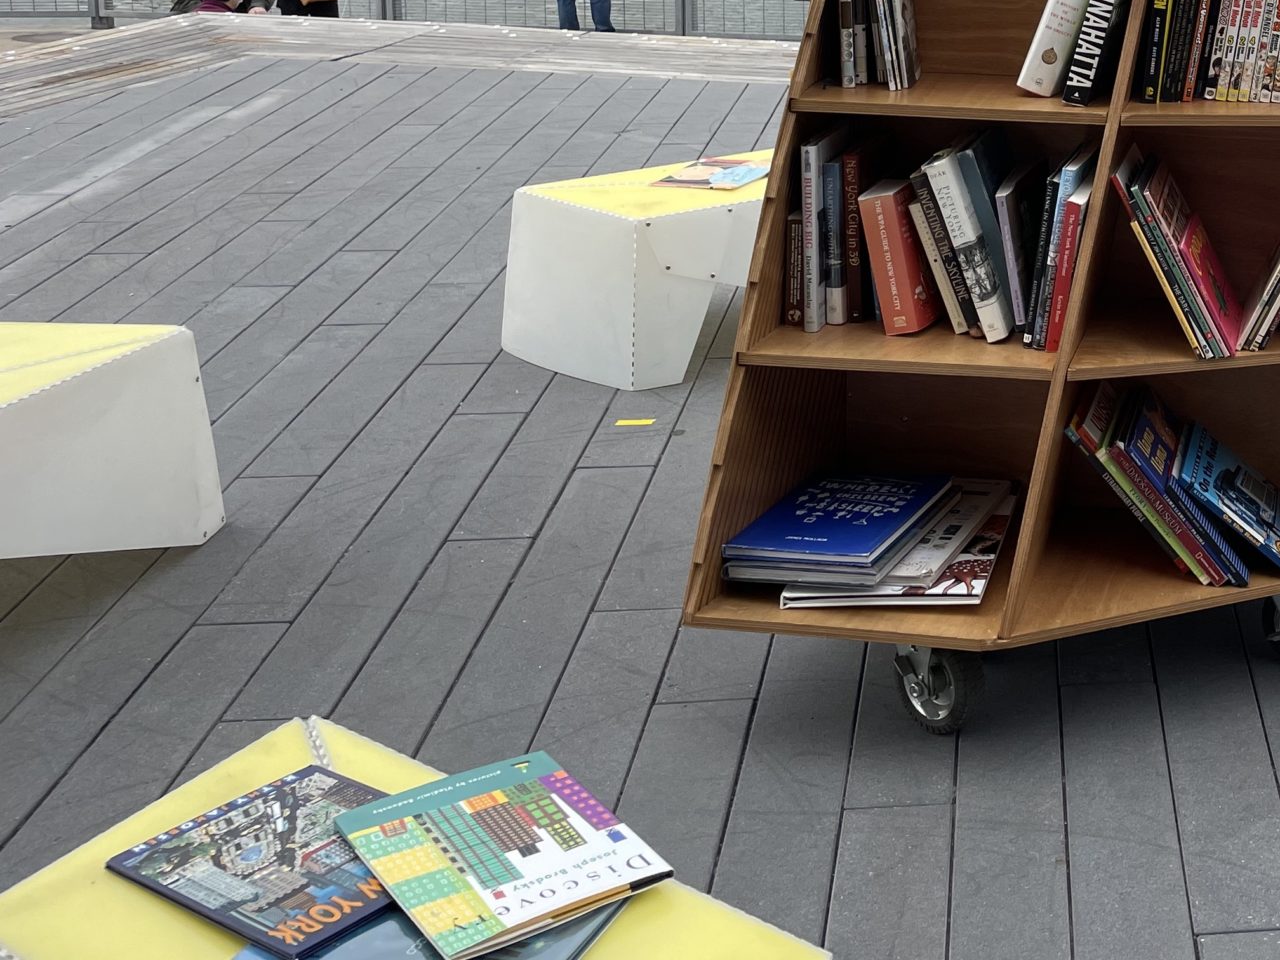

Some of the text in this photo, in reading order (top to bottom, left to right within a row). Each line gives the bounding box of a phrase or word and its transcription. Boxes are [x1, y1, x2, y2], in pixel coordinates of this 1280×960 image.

[1229, 9, 1238, 27] Moon
[1241, 10, 1250, 27] Moon
[1251, 10, 1260, 27] Moon
[1227, 36, 1234, 45] 5
[1239, 36, 1246, 46] 2
[1249, 36, 1256, 45] 4
[873, 200, 882, 214] THE
[1043, 185, 1052, 211] TITANIC
[1052, 170, 1072, 245] BEYOND THE EDGE
[803, 177, 813, 248] BUILDING BIG
[845, 159, 858, 266] New York City in 3D
[935, 186, 959, 239] NEW YORK
[942, 185, 965, 238] PICTURING
[1042, 212, 1048, 220] IN
[878, 228, 889, 251] GUIDE
[917, 186, 968, 302] INVENTING THE SKYLINE
[883, 251, 891, 261] TO
[885, 261, 894, 277] NEW
[1060, 249, 1071, 277] Waterfront
[804, 277, 812, 308] Macaulay
[888, 277, 897, 296] YORK
[1171, 284, 1189, 313] THE DARK
[891, 295, 901, 311] CITY
[1055, 294, 1064, 311] Kevin
[1039, 311, 1050, 346] WATERFRONT
[1199, 477, 1210, 492] On
[1205, 460, 1215, 478] the
[1118, 456, 1182, 534] THE DINOSAUR MUSEUM
[1129, 504, 1145, 522] PEOPLE
[1221, 513, 1260, 547] On the Road
[468, 770, 502, 785] pictures
[418, 785, 453, 801] Vladimir
[132, 774, 297, 853] KATHY JAKOBSEN
[511, 848, 618, 891] Joseph Brodsky
[451, 851, 653, 933] Discovery
[267, 896, 364, 946] YORK
